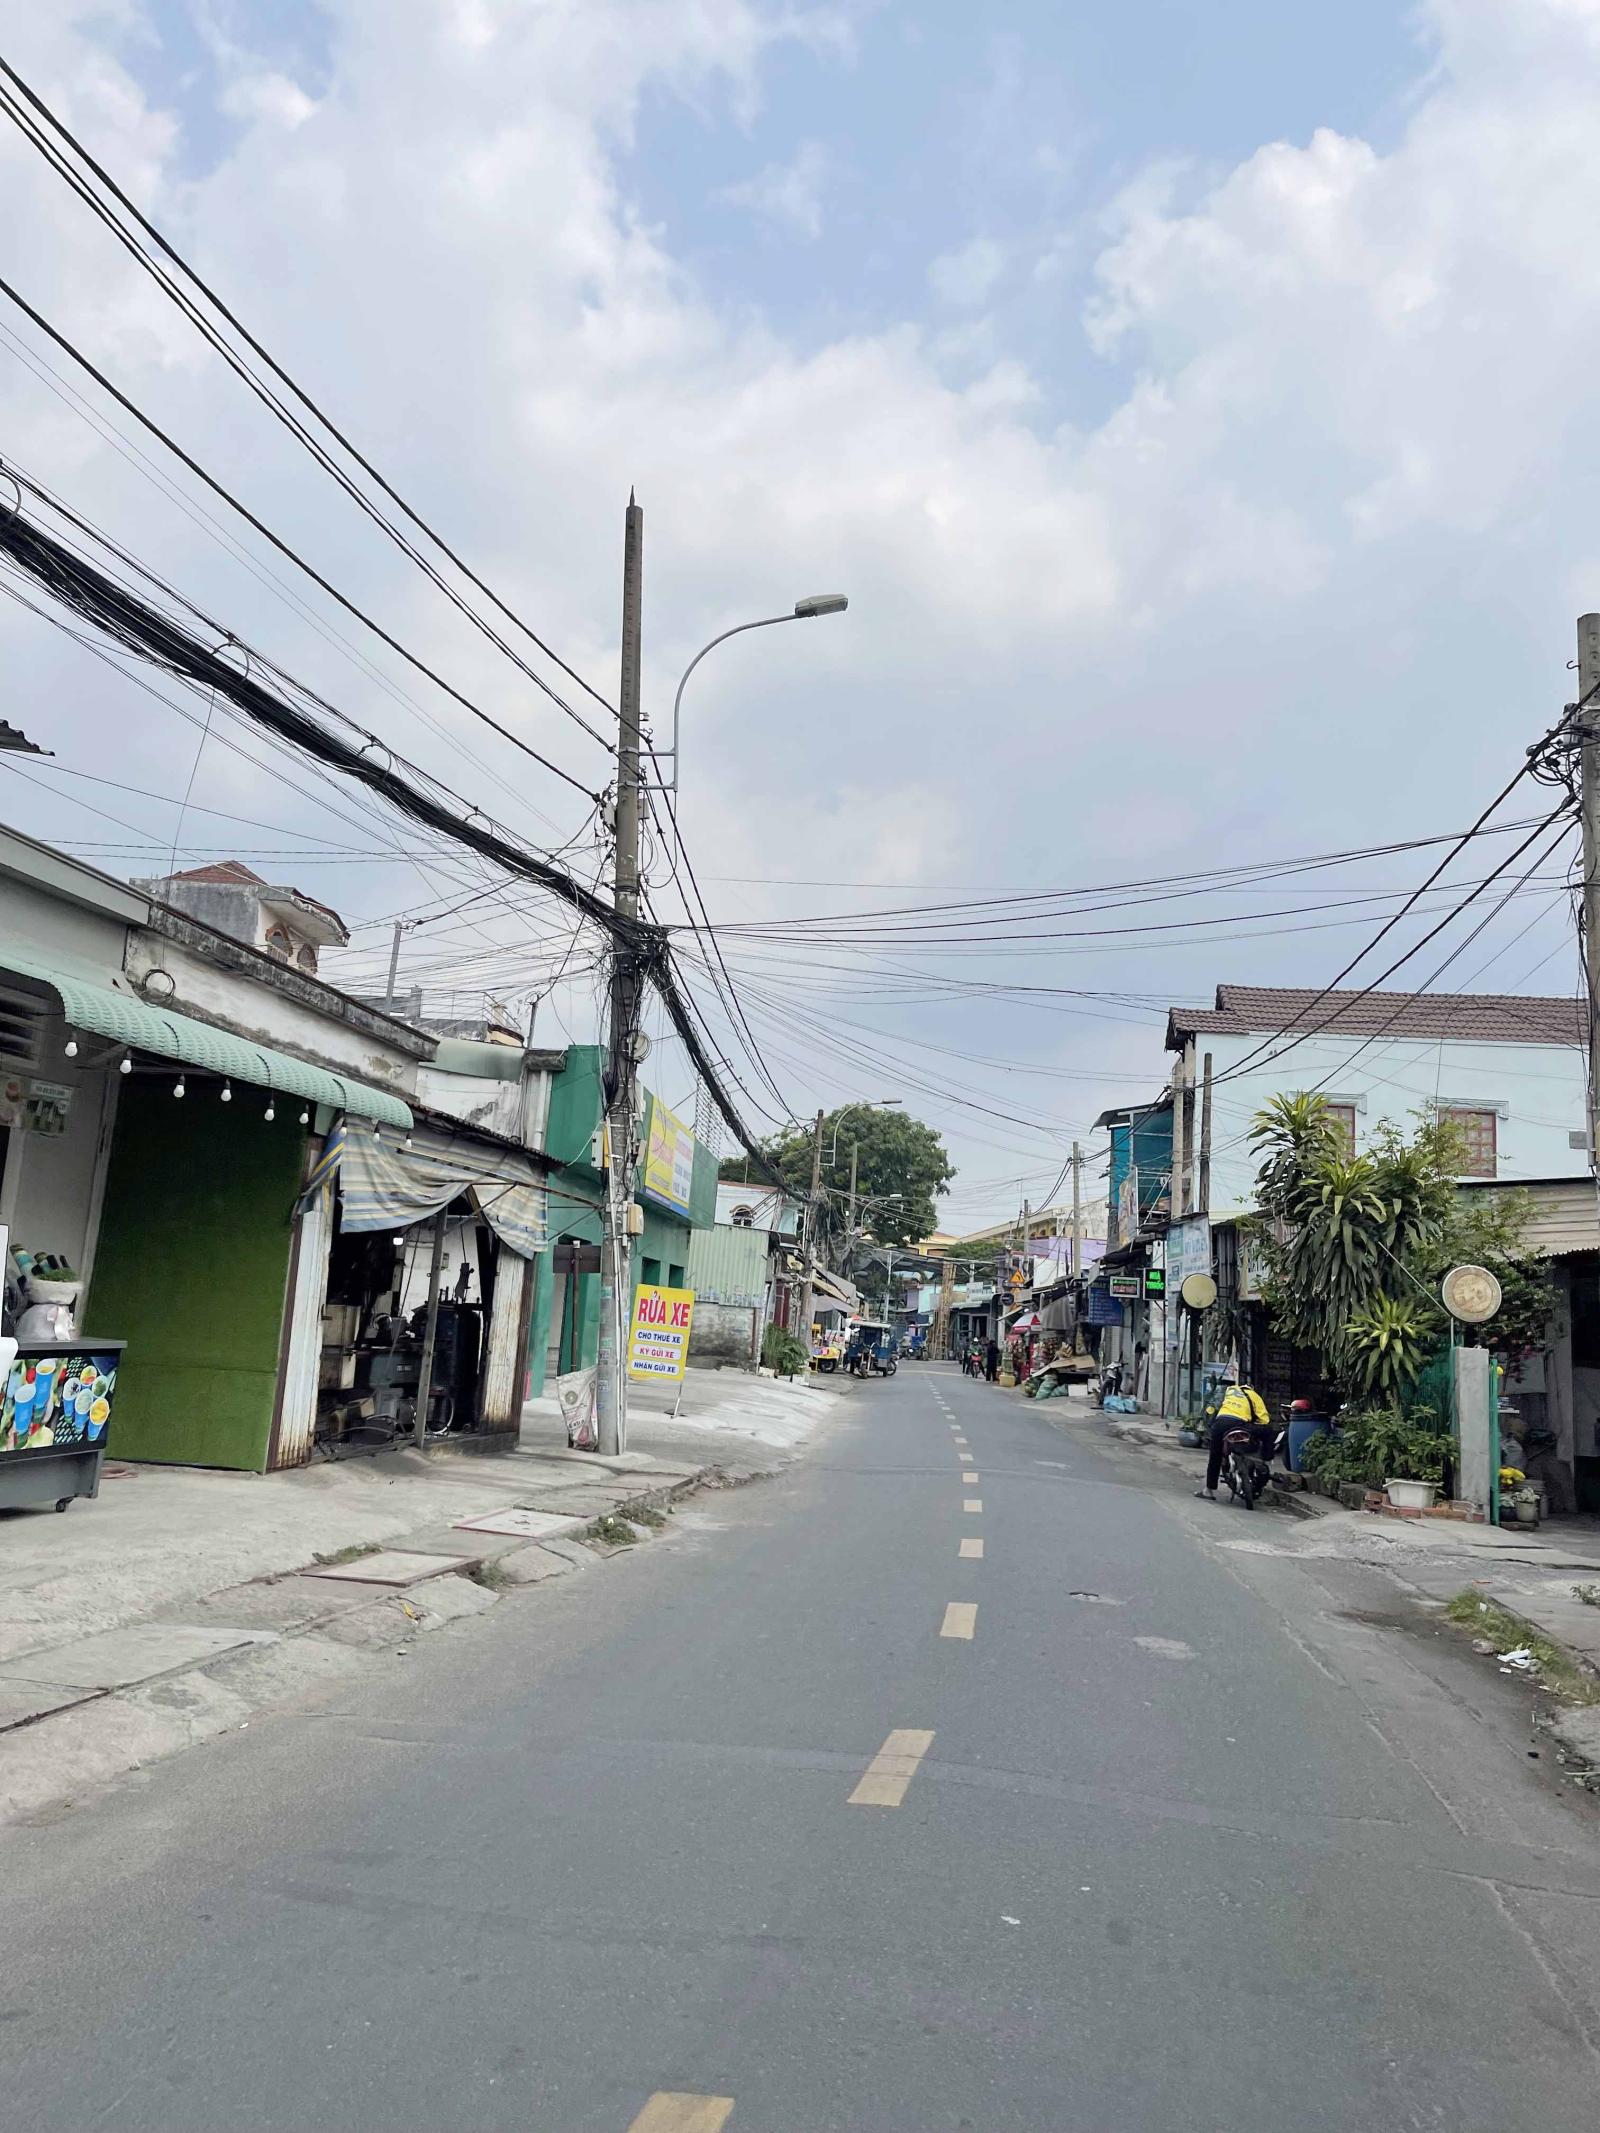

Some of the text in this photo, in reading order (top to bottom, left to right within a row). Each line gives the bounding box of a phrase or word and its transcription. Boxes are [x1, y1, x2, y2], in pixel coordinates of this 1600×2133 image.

[638, 1290, 690, 1327] RỬA XE
[637, 1331, 651, 1340] CHO
